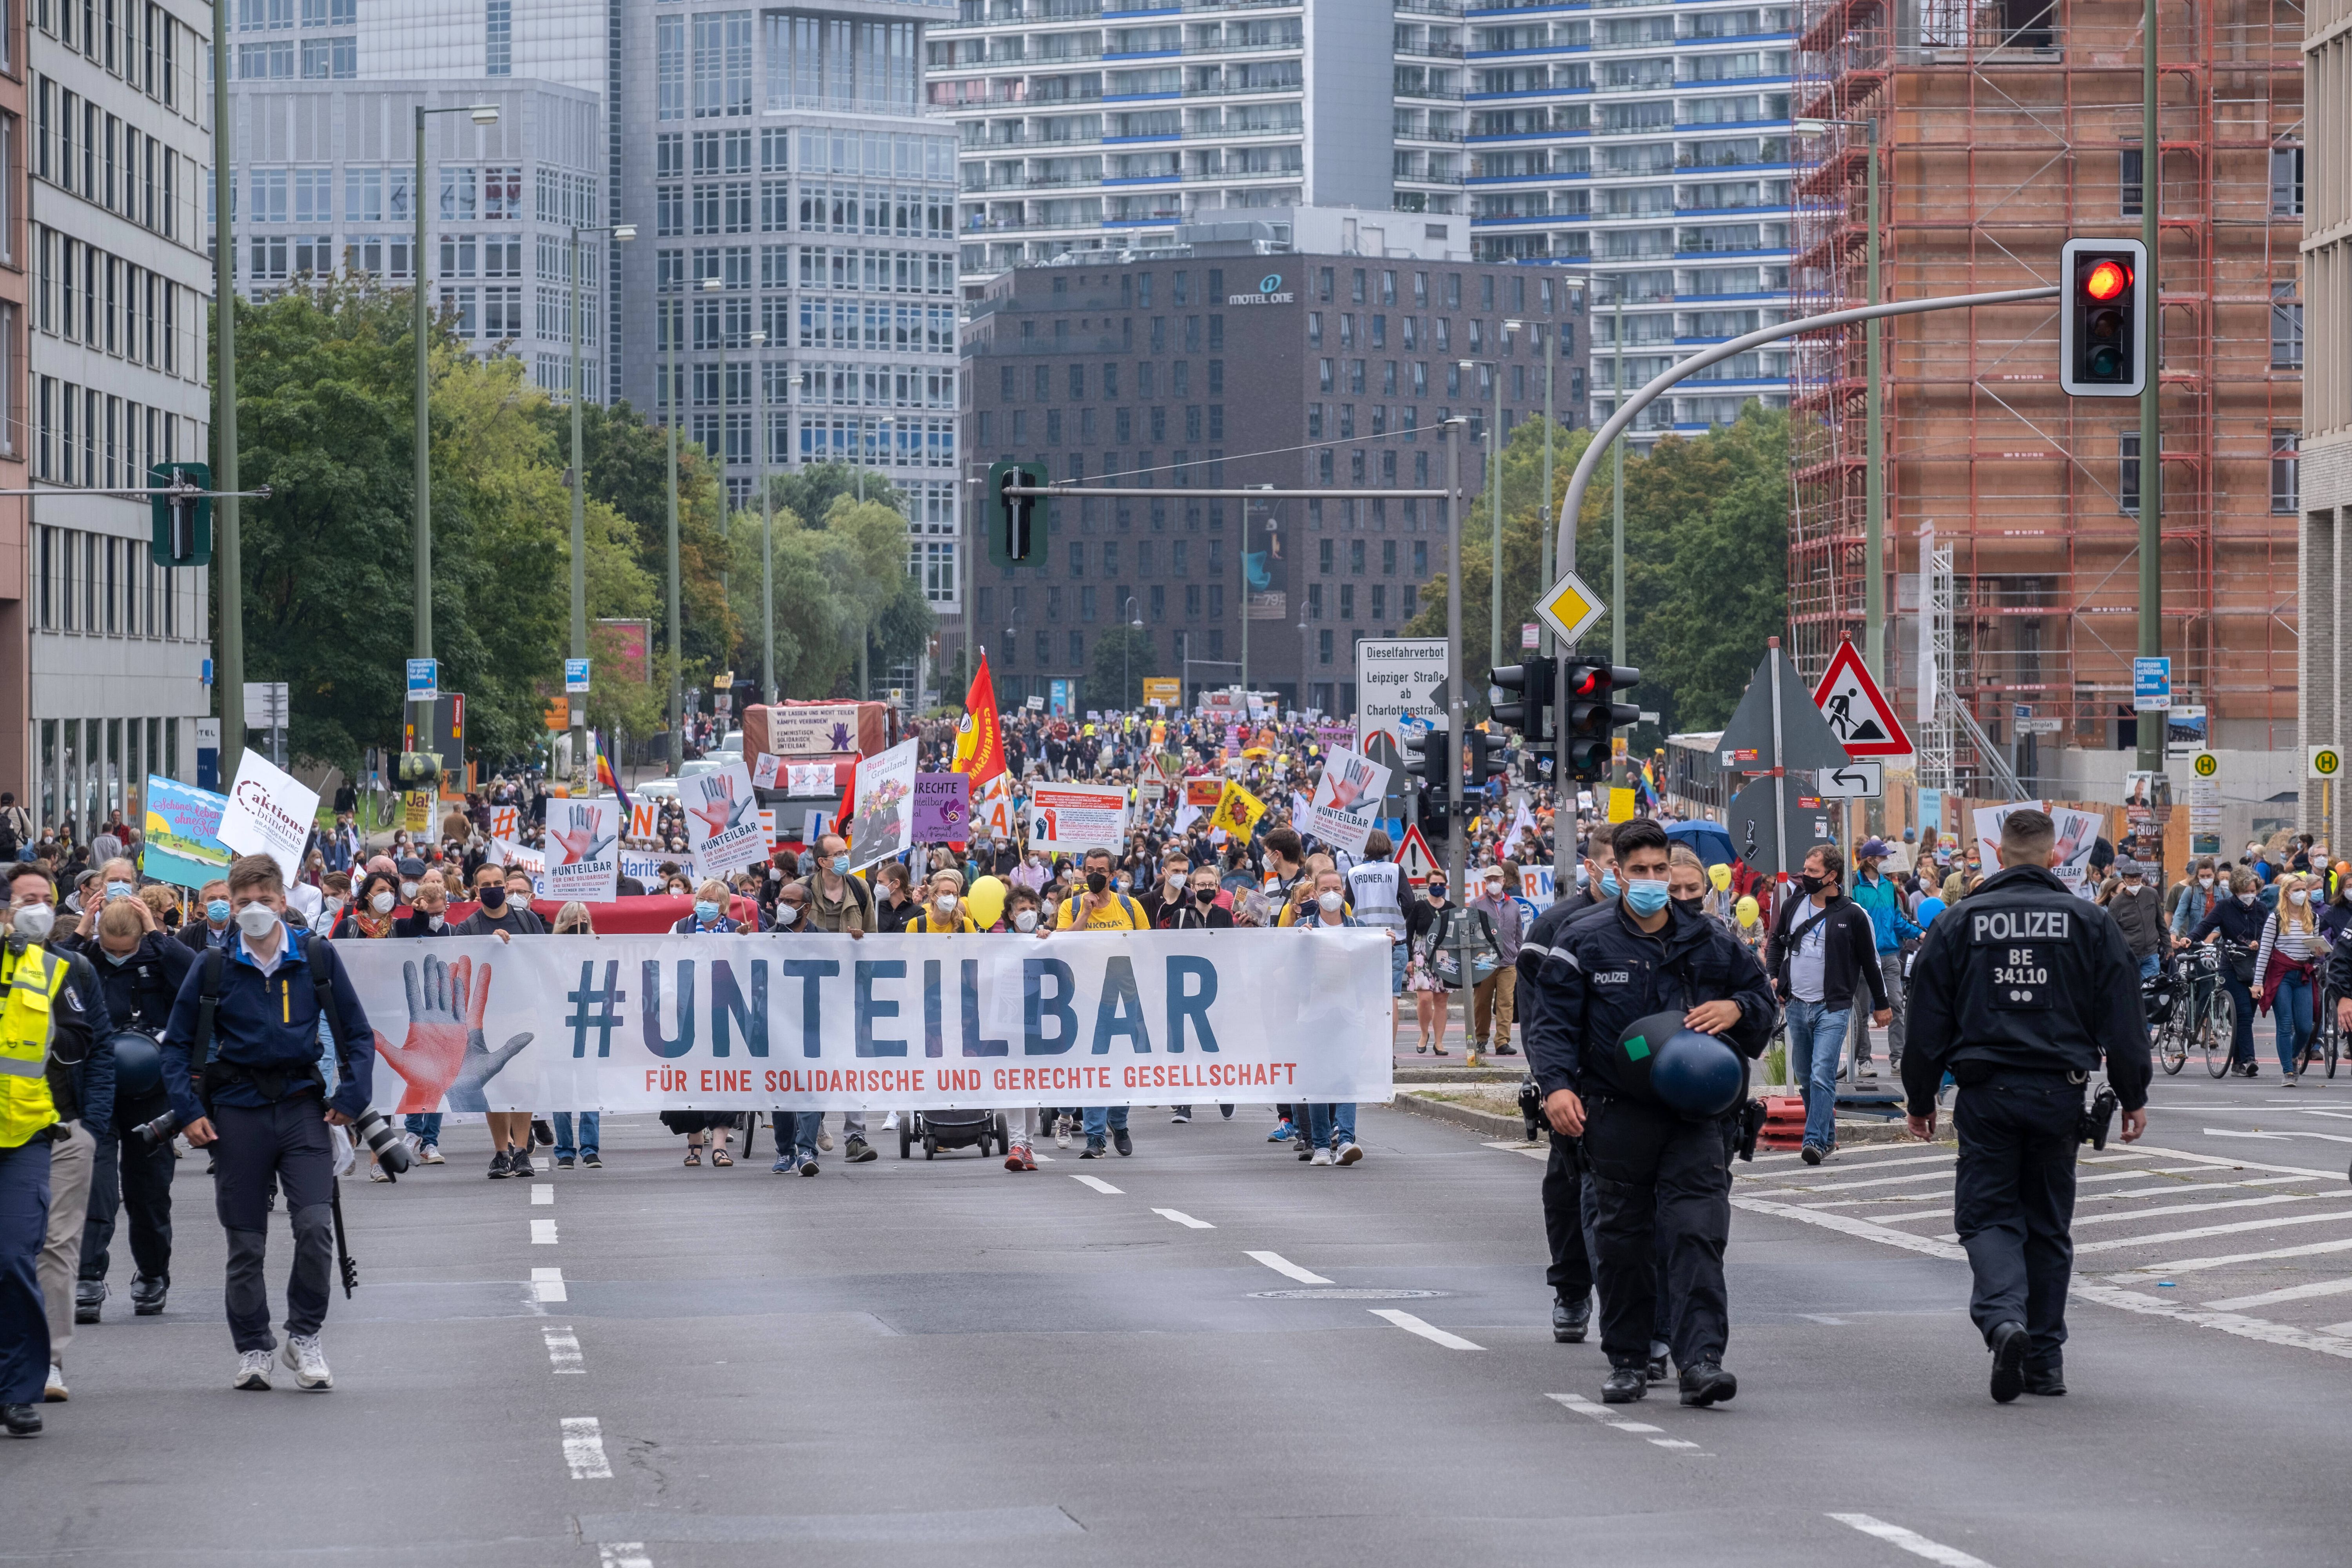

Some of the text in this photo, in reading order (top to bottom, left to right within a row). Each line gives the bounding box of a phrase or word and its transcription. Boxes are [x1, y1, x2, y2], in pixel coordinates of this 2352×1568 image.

[1229, 292, 1294, 305] MOTEL ONE
[1367, 647, 1444, 657] Dieselfahrverbot
[1367, 671, 1444, 685] Leipziger Straße
[1400, 688, 1411, 699] ab
[969, 707, 994, 780] GEMEINSAM
[866, 753, 898, 772] Bunt statt
[871, 756, 908, 779] Grauland
[2201, 759, 2212, 771] H
[2321, 756, 2332, 769] H
[914, 782, 958, 794] NRECHTE
[407, 792, 429, 808] Ja!
[914, 797, 944, 806] nteilbar
[151, 798, 220, 820] Schöner leben
[252, 794, 305, 835] aktions
[1316, 805, 1368, 828] #UNTEILBAR
[174, 812, 196, 825] ohne
[257, 807, 302, 845] bündnis
[492, 808, 516, 841] #
[633, 804, 653, 837] N
[990, 803, 1007, 836] A
[254, 819, 298, 853] BRANDENBURG
[1335, 822, 1364, 835] SOLIDARISCHE
[701, 822, 758, 852] #UNTEILBAR
[726, 834, 759, 850] SOLIDARISCHE
[714, 851, 732, 860] GERECHTE
[733, 841, 759, 853] GESELLSCHAFT
[552, 861, 612, 877] #UNTEILBAR
[711, 857, 730, 866] SEPTEMBER
[1354, 874, 1392, 885] ORDNER.IN
[2052, 867, 2082, 877] TEILBAR
[1975, 912, 2069, 941] POLIZEI
[2009, 949, 2033, 965] BE
[1594, 972, 1629, 984] POLIZEI
[1994, 967, 2047, 984] 34110
[565, 955, 1221, 1059] #UNTEILBAR
[646, 1063, 1296, 1091] FÜR EINE SOLIDARISCHE UND GERECHTE GESELLSCHAFT
